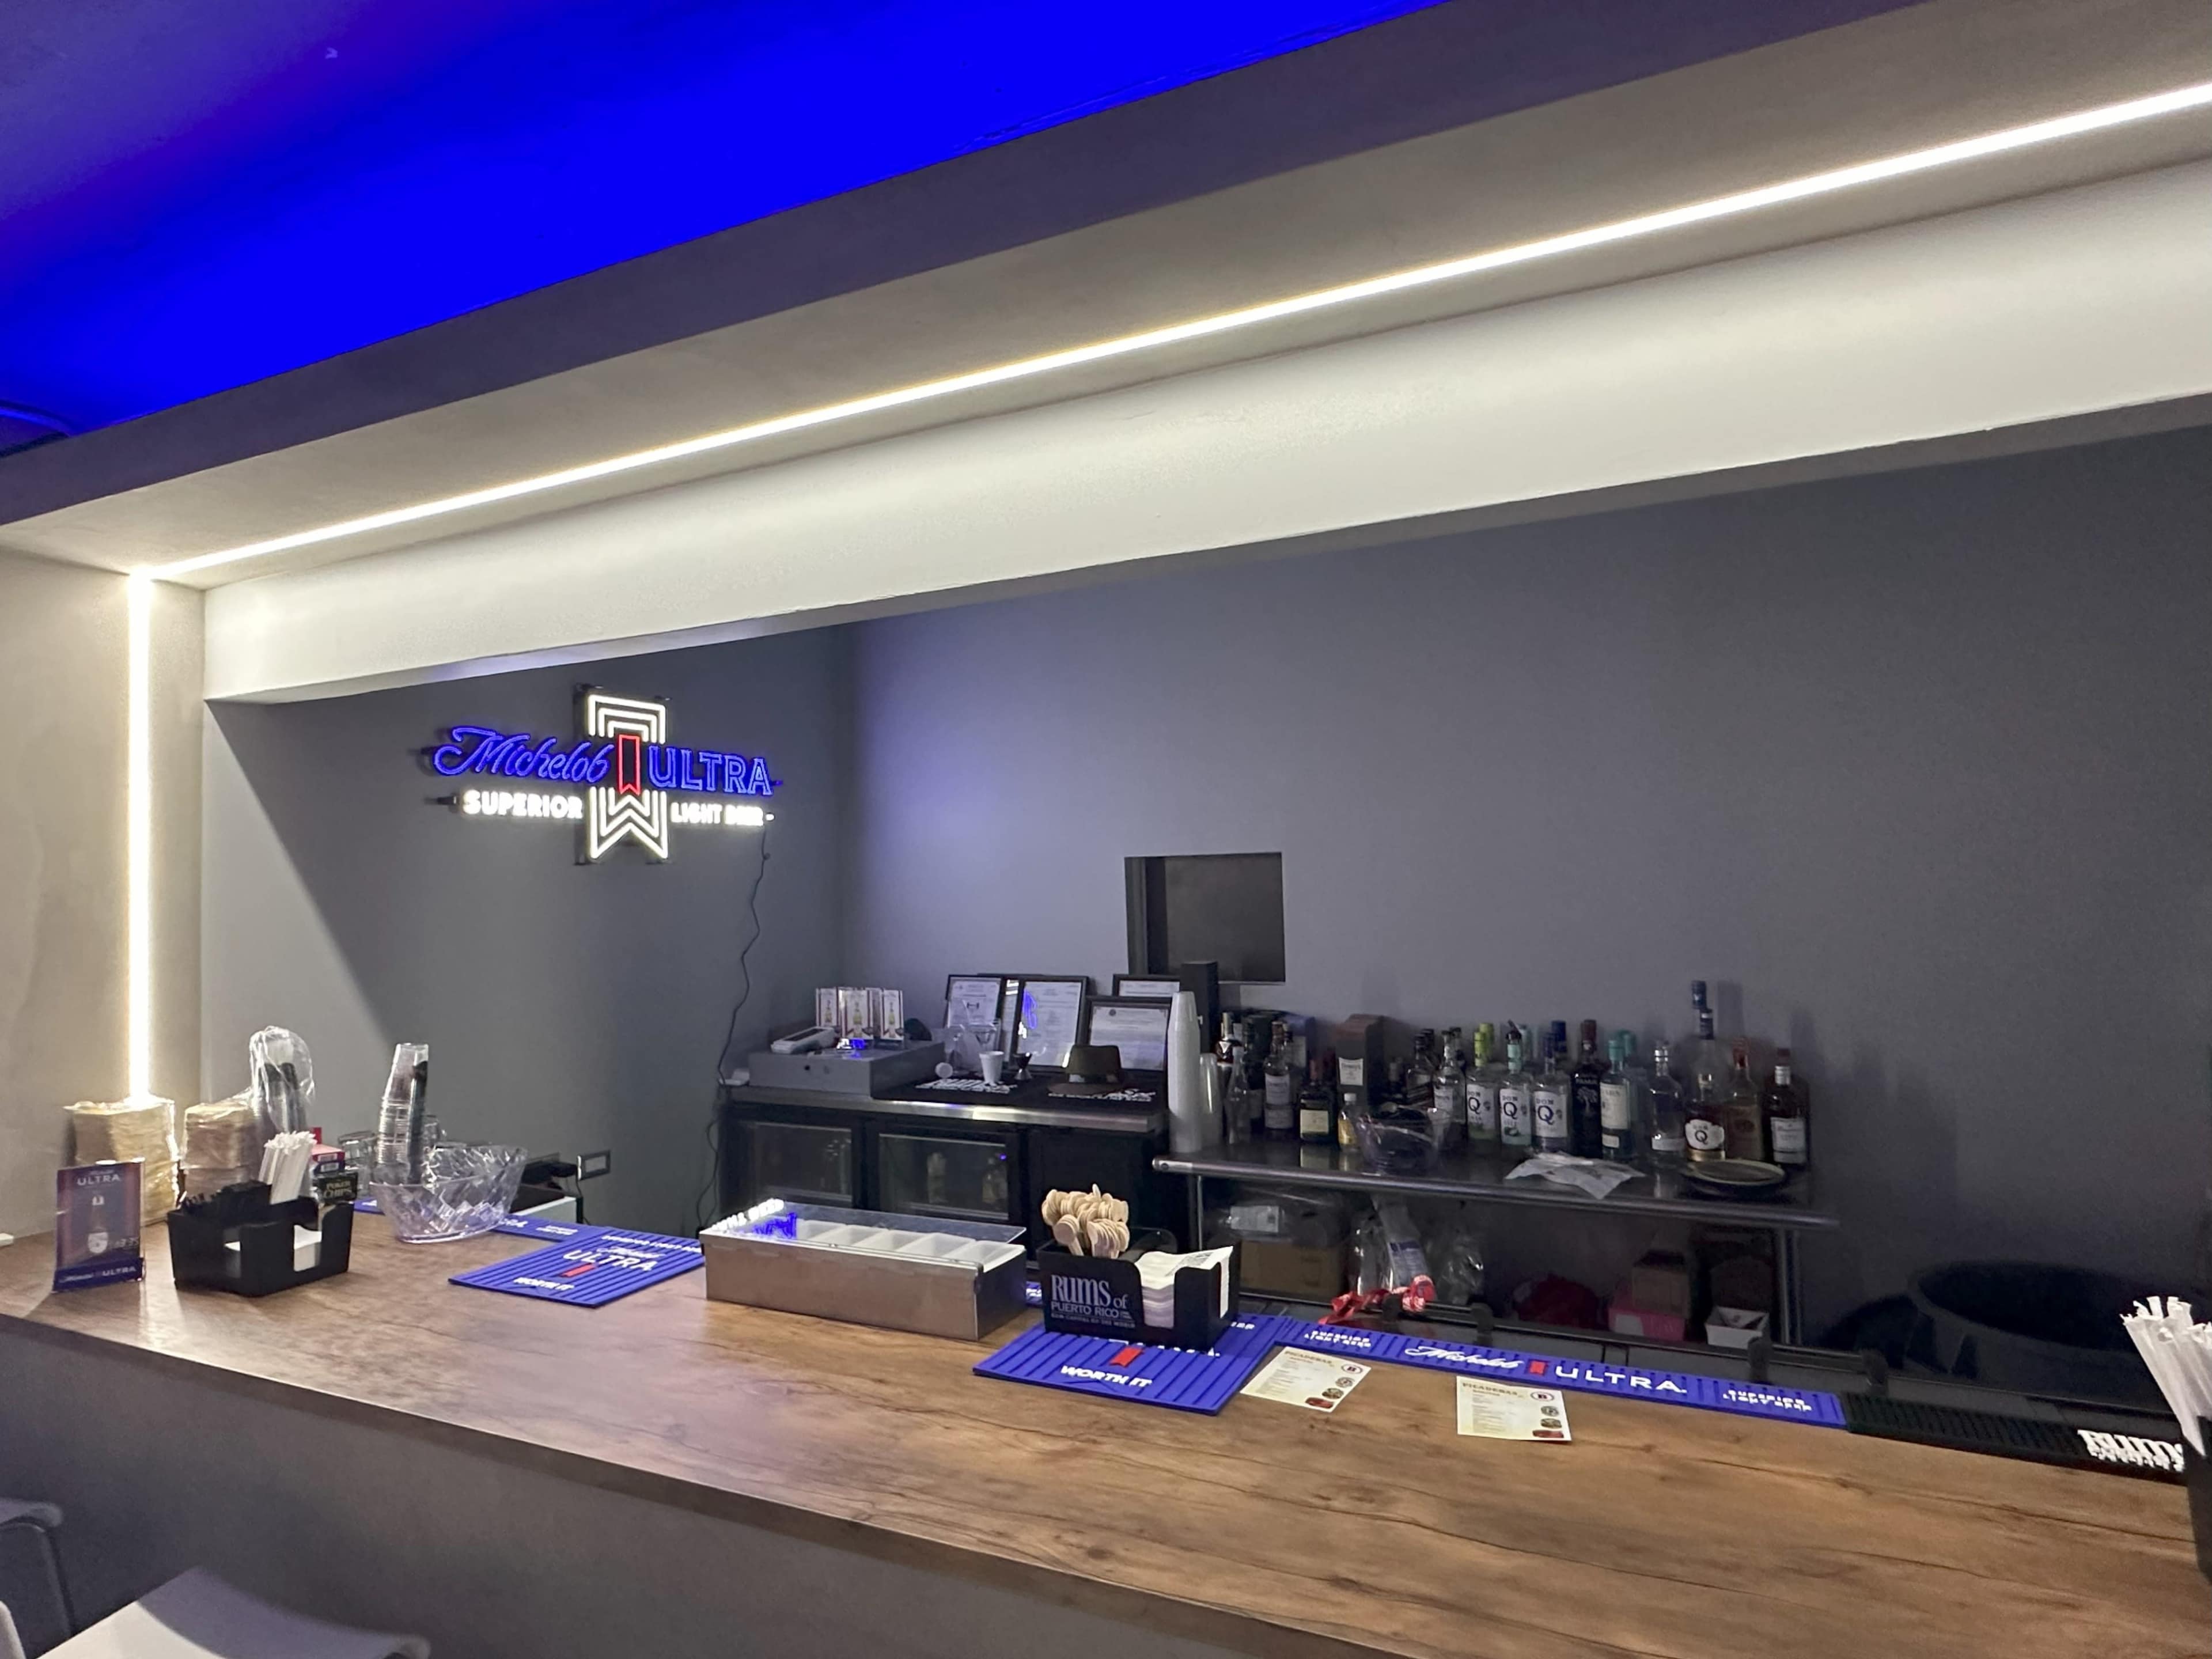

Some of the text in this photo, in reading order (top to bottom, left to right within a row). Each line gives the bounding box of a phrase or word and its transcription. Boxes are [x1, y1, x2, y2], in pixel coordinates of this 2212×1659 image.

[434, 727, 774, 796] Michelob ULTRA
[463, 789, 584, 819] SUPERIOR
[671, 801, 722, 824] LIGHT
[1468, 1097, 1481, 1115] Q
[1503, 1101, 1518, 1120] Q
[1537, 1104, 1555, 1126] Q
[1695, 1130, 1709, 1145] Q
[76, 1173, 121, 1186] ULTRA
[563, 1249, 658, 1271] ULTRA
[1051, 1300, 1092, 1315] PUERTO
[1094, 1306, 1119, 1319] RICO
[1113, 1294, 1128, 1309] of
[1060, 1364, 1153, 1388] WORTH IT
[1404, 1346, 1682, 1393] Michelob ULTRA
